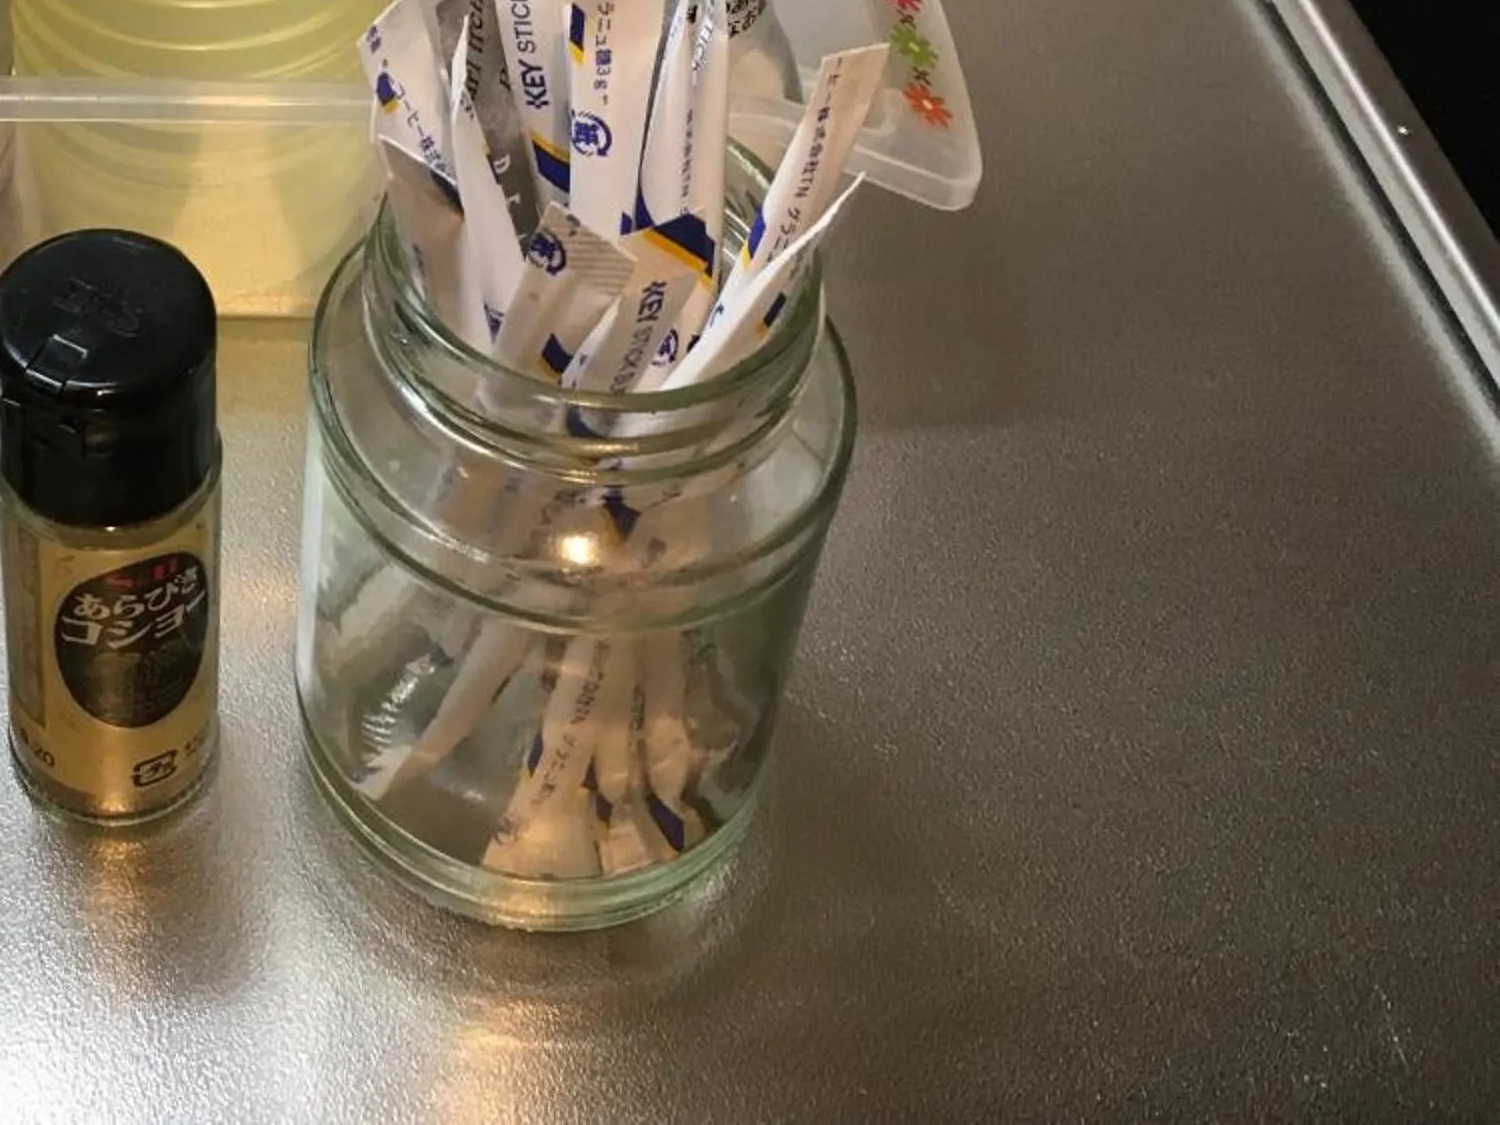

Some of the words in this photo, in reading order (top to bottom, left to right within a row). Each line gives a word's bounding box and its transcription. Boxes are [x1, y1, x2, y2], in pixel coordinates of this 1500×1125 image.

[522, 59, 549, 111] KEY
[73, 565, 200, 621] あらびき
